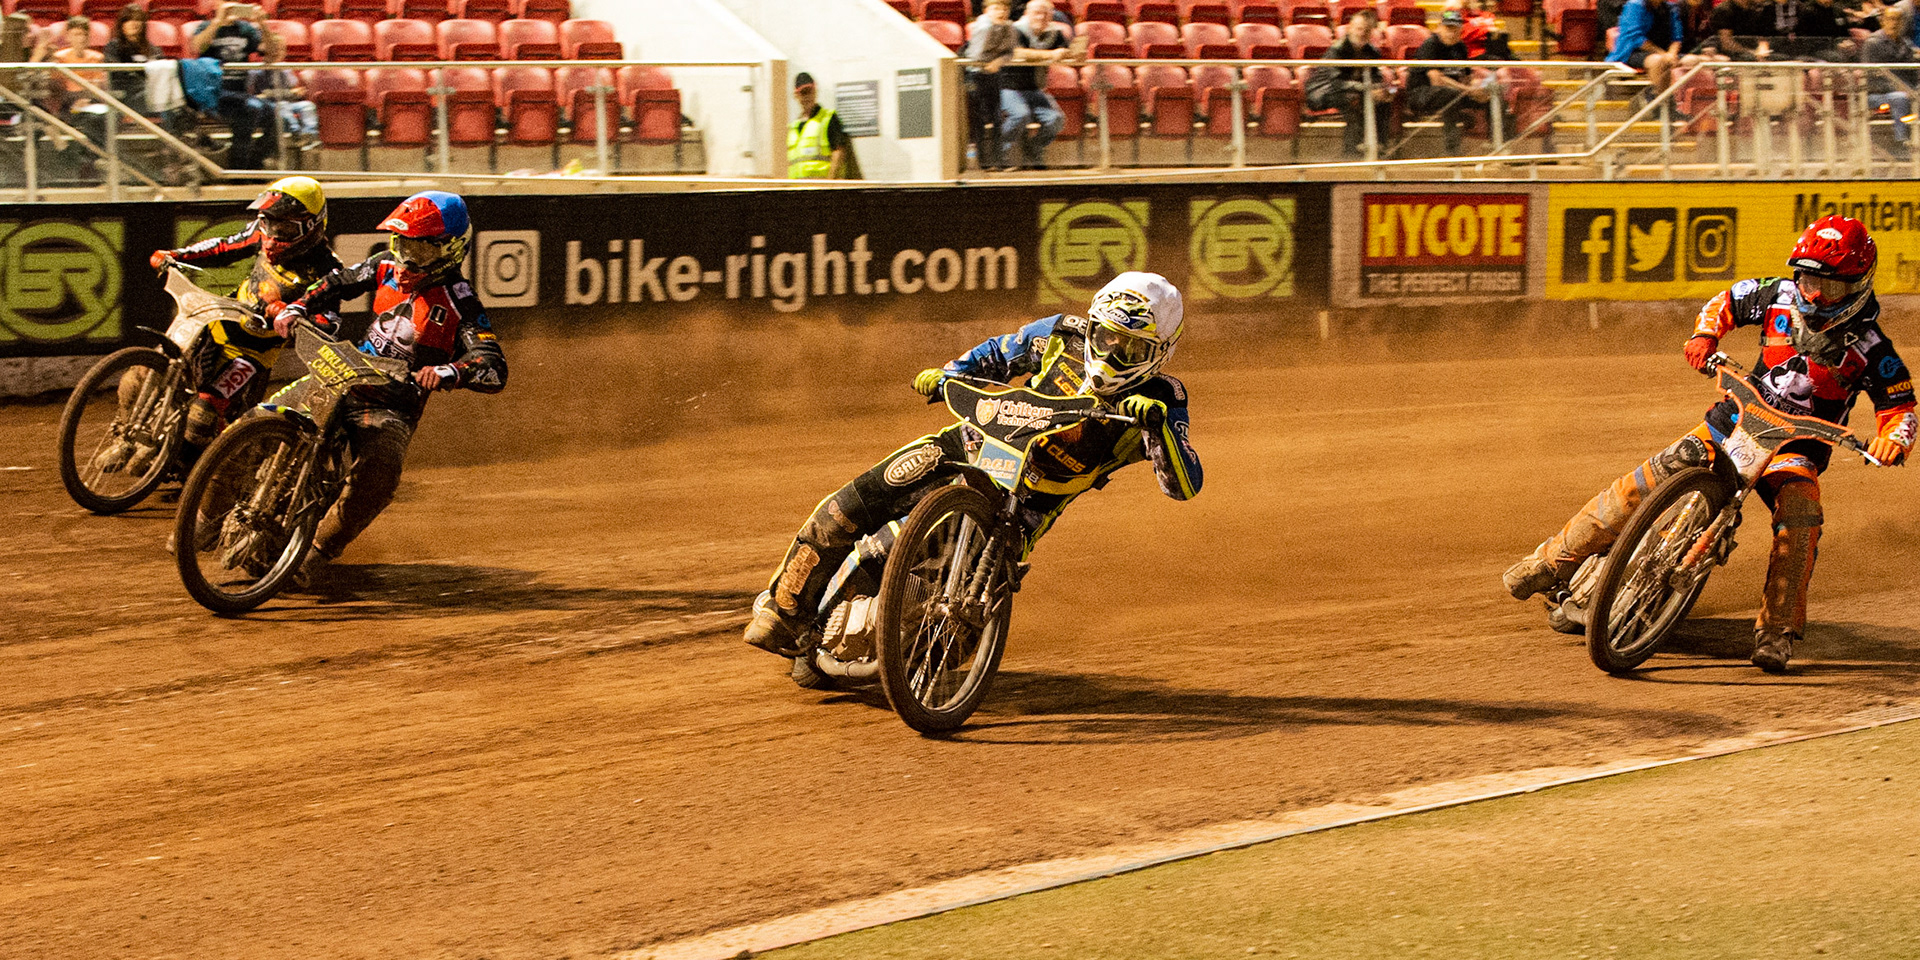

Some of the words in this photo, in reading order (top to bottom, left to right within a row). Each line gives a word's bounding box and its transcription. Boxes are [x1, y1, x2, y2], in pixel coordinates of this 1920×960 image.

[1367, 203, 1524, 257] HYCOTE
[565, 233, 1018, 312] bike-right.com
[219, 361, 255, 394] NGK
[1000, 400, 1053, 419] Chiltern
[1047, 444, 1087, 474] CUBS
